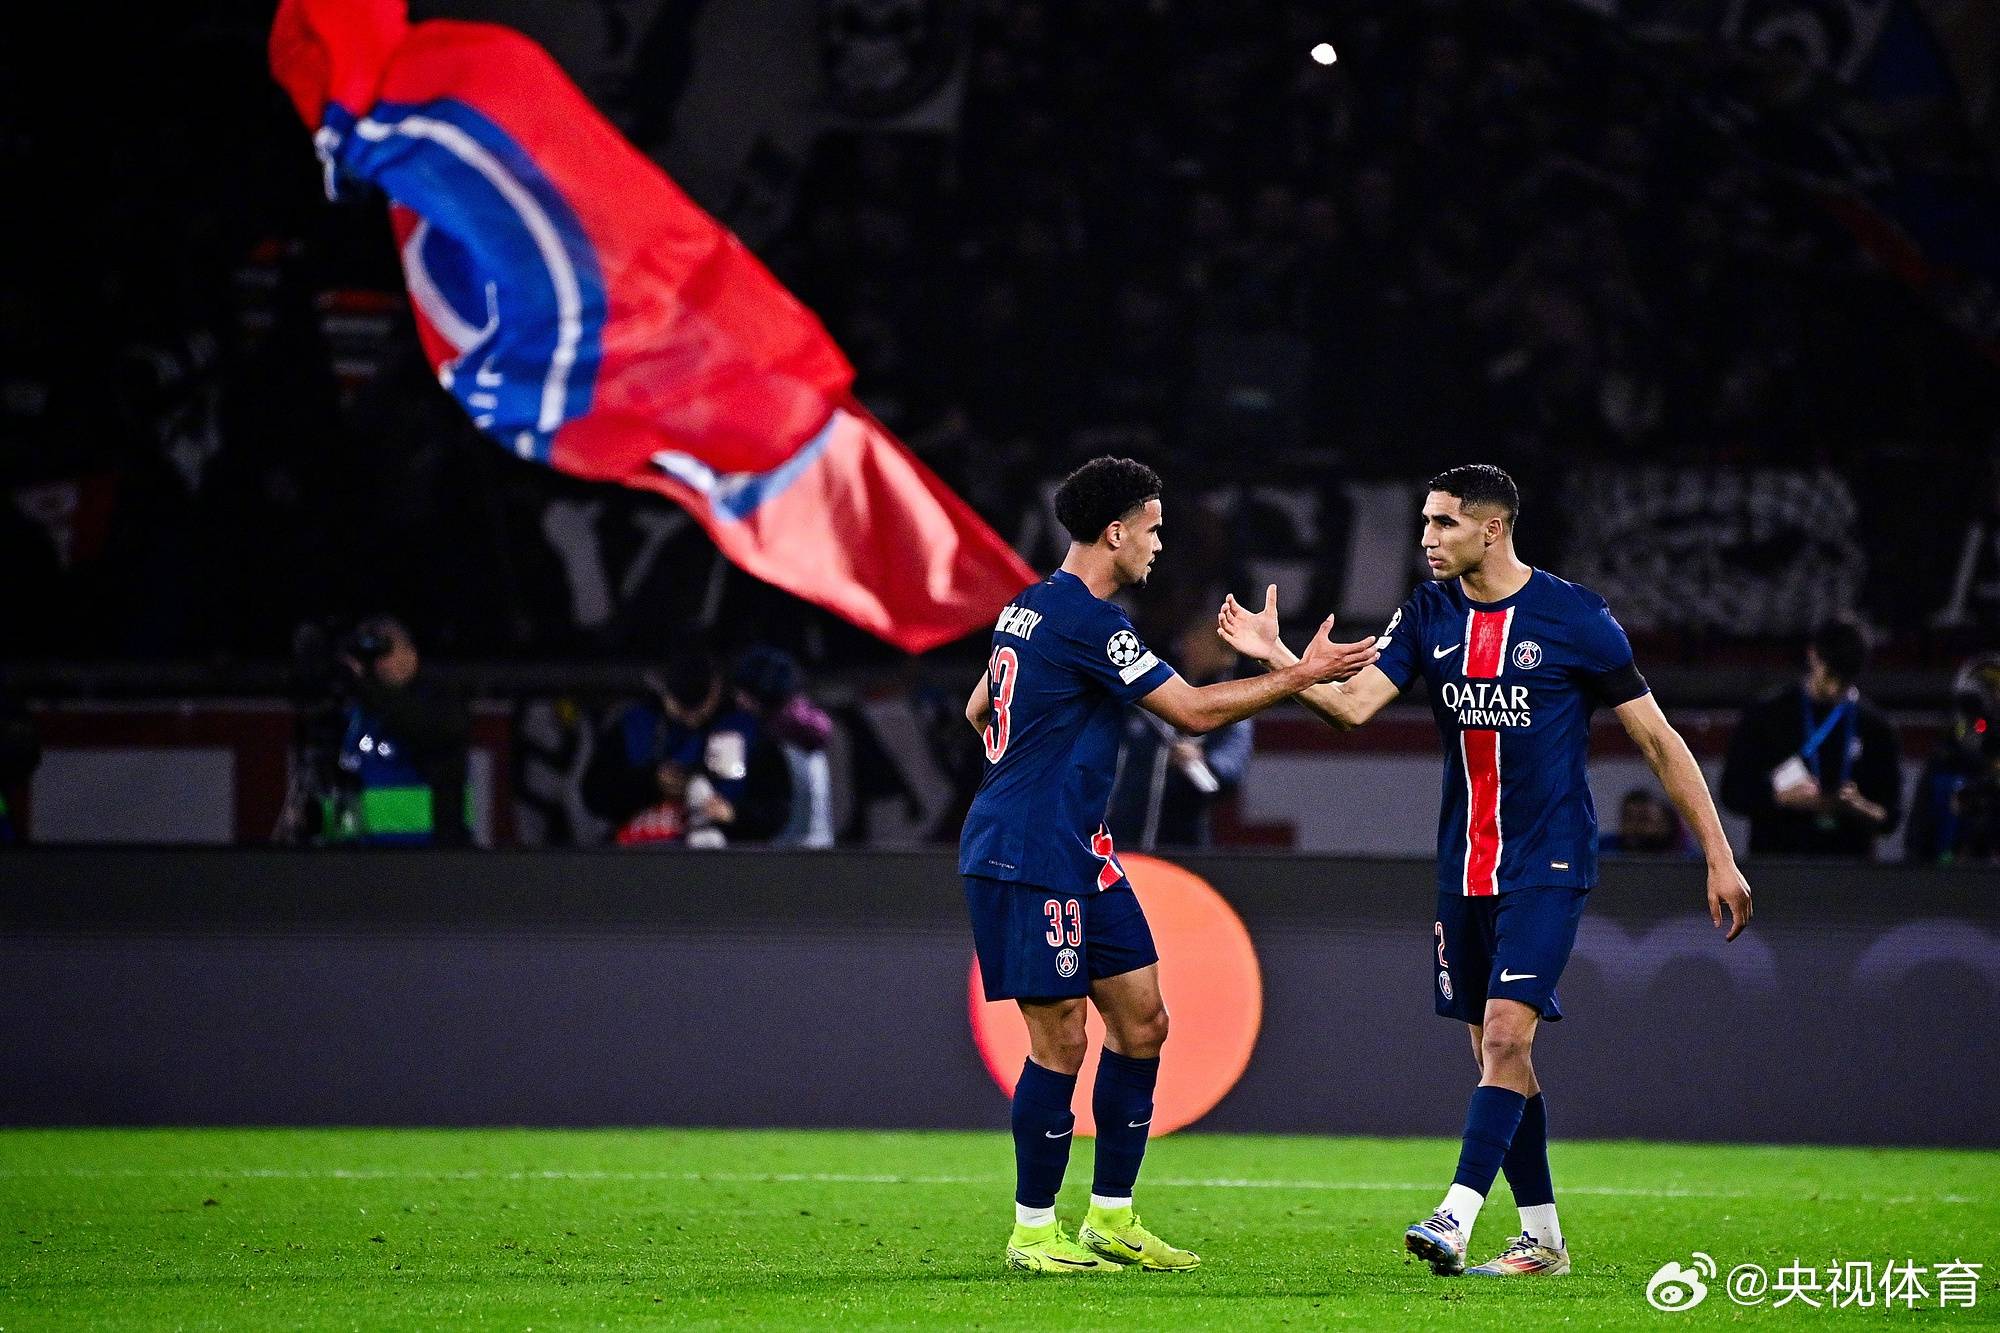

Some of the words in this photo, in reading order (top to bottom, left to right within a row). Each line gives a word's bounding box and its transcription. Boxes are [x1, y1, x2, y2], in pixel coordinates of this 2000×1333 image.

[983, 645, 1018, 764] 3
[1442, 682, 1530, 712] QATAR
[1457, 709, 1532, 727] AIRWAYS
[1044, 898, 1082, 947] 33
[1434, 921, 1449, 969] 2
